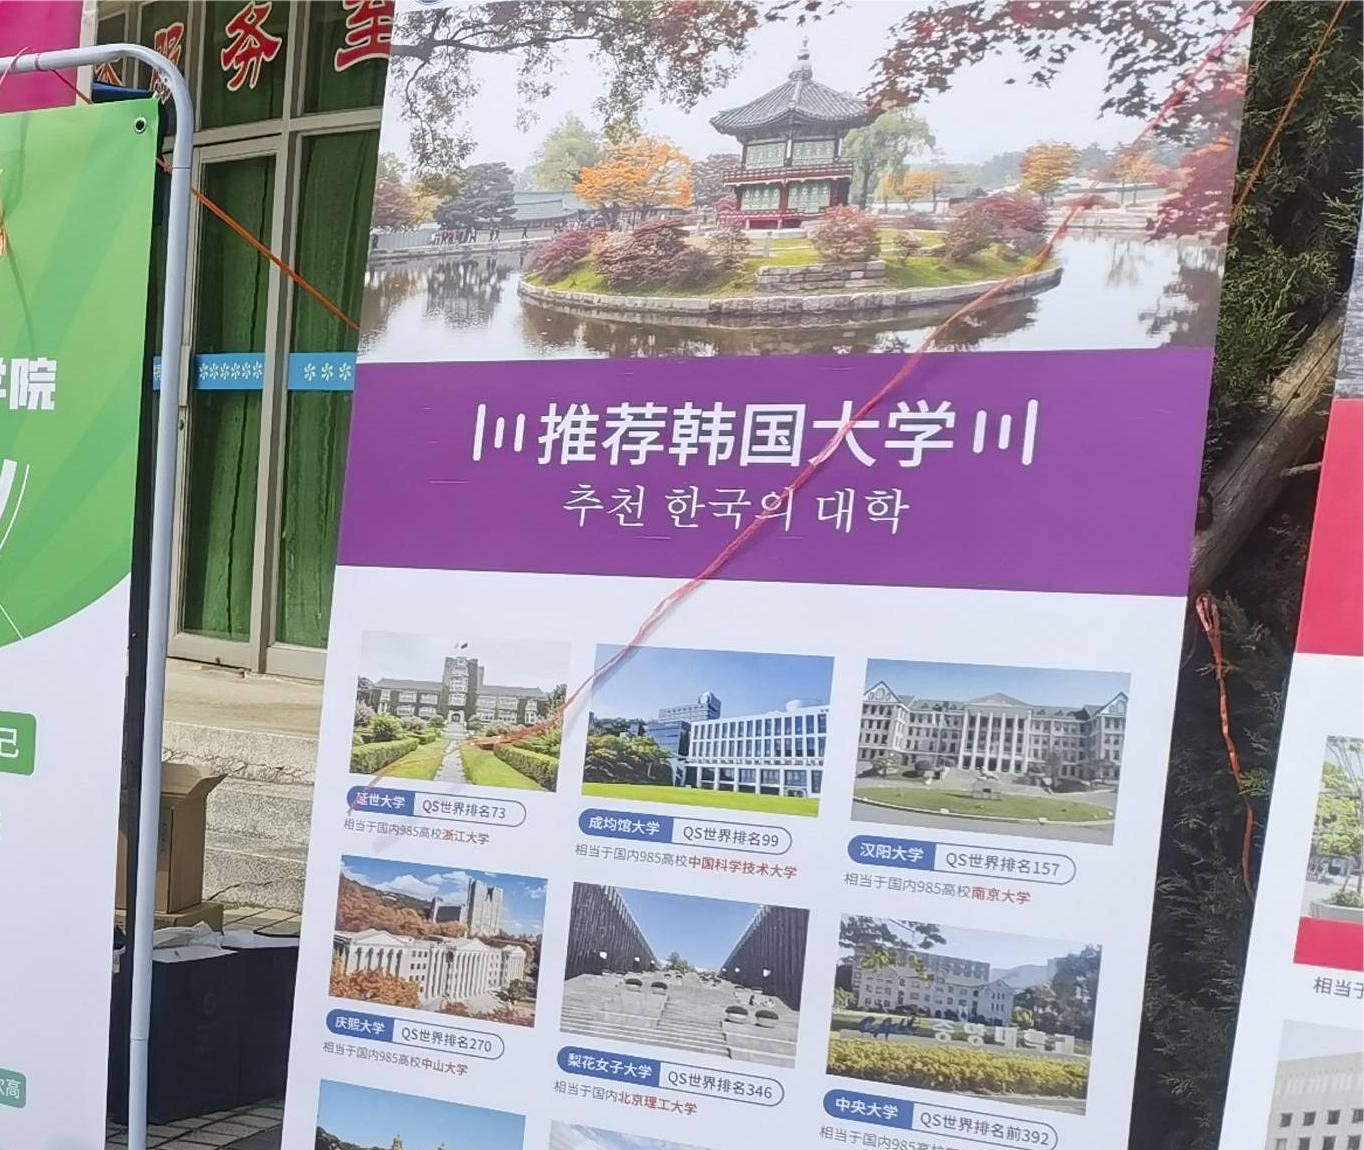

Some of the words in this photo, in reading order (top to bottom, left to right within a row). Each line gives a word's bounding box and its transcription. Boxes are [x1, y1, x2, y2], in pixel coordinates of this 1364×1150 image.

[537, 399, 956, 468] 推荐韩国大学
[562, 482, 647, 529] 추천
[665, 484, 795, 533] 한국의
[816, 486, 910, 536] 대학
[355, 791, 406, 809] 延世大学
[422, 799, 506, 819] QS世界排名73
[343, 818, 490, 846] 相当于国内985高校浙江大学
[588, 815, 661, 836] 成均馆大学
[682, 825, 779, 848] QS世界排名99
[574, 842, 798, 879] 相当于国内985高校中国科学技术大学
[859, 840, 925, 863] 汉阳大学
[945, 850, 1061, 877] QS世界排名157
[843, 871, 1031, 905] 相当于国内985高校南京大学
[334, 1015, 386, 1035] 庆熙大学
[401, 1026, 493, 1053] QS世界排名270
[323, 1041, 469, 1077] 相当于国内985高校中山大学
[567, 1052, 653, 1080] 梨花女子大学
[667, 1070, 773, 1100] QS世界排名346
[554, 1079, 698, 1115] 相当于国内北京理工大学
[835, 1095, 899, 1120] 中央大学
[919, 1111, 1050, 1147] QS世界排名前392
